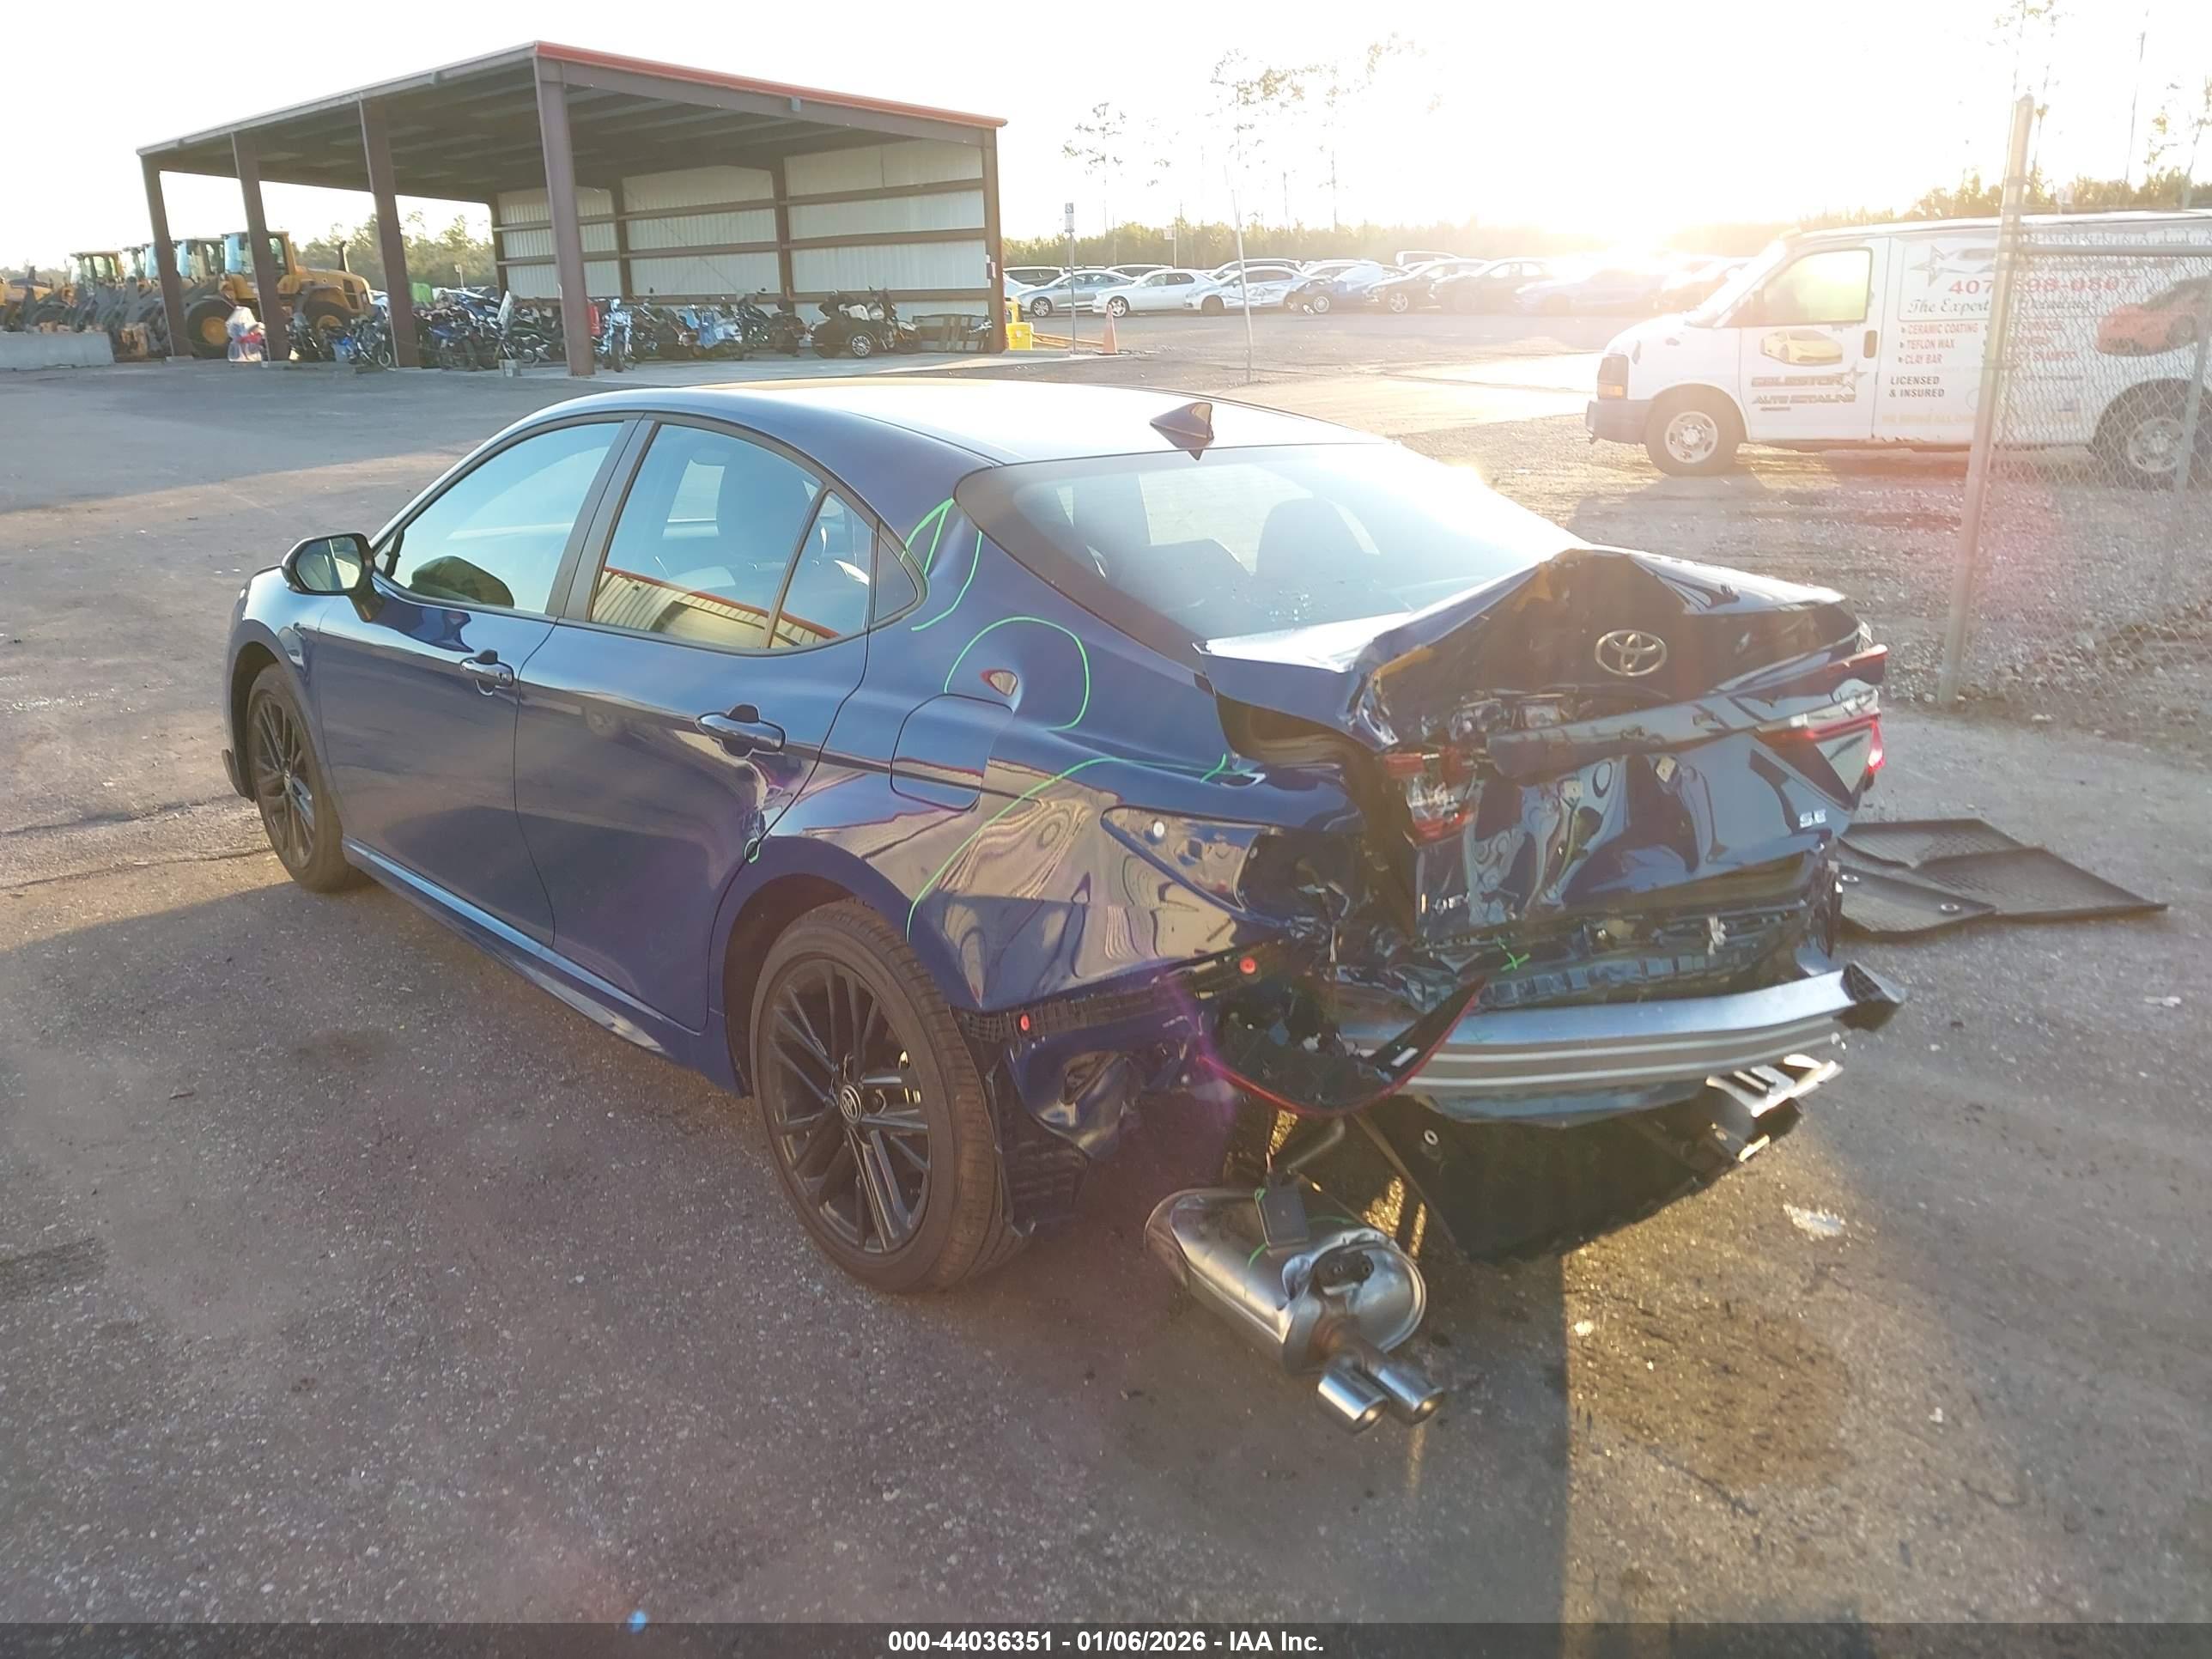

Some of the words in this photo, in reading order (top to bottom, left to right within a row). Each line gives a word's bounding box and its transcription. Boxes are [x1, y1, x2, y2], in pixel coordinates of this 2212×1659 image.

[1907, 298, 1936, 313] The
[1907, 323, 1943, 335] CERAMIC
[1944, 322, 1979, 334] COATING
[1906, 338, 1936, 349] TEFLON
[1937, 338, 1955, 349] WAX
[1905, 354, 1924, 364] CLAY
[1925, 353, 1943, 364] BAR
[1890, 375, 1940, 386] LICENSED
[1888, 388, 1897, 398] &
[1899, 388, 1945, 398] INSURED
